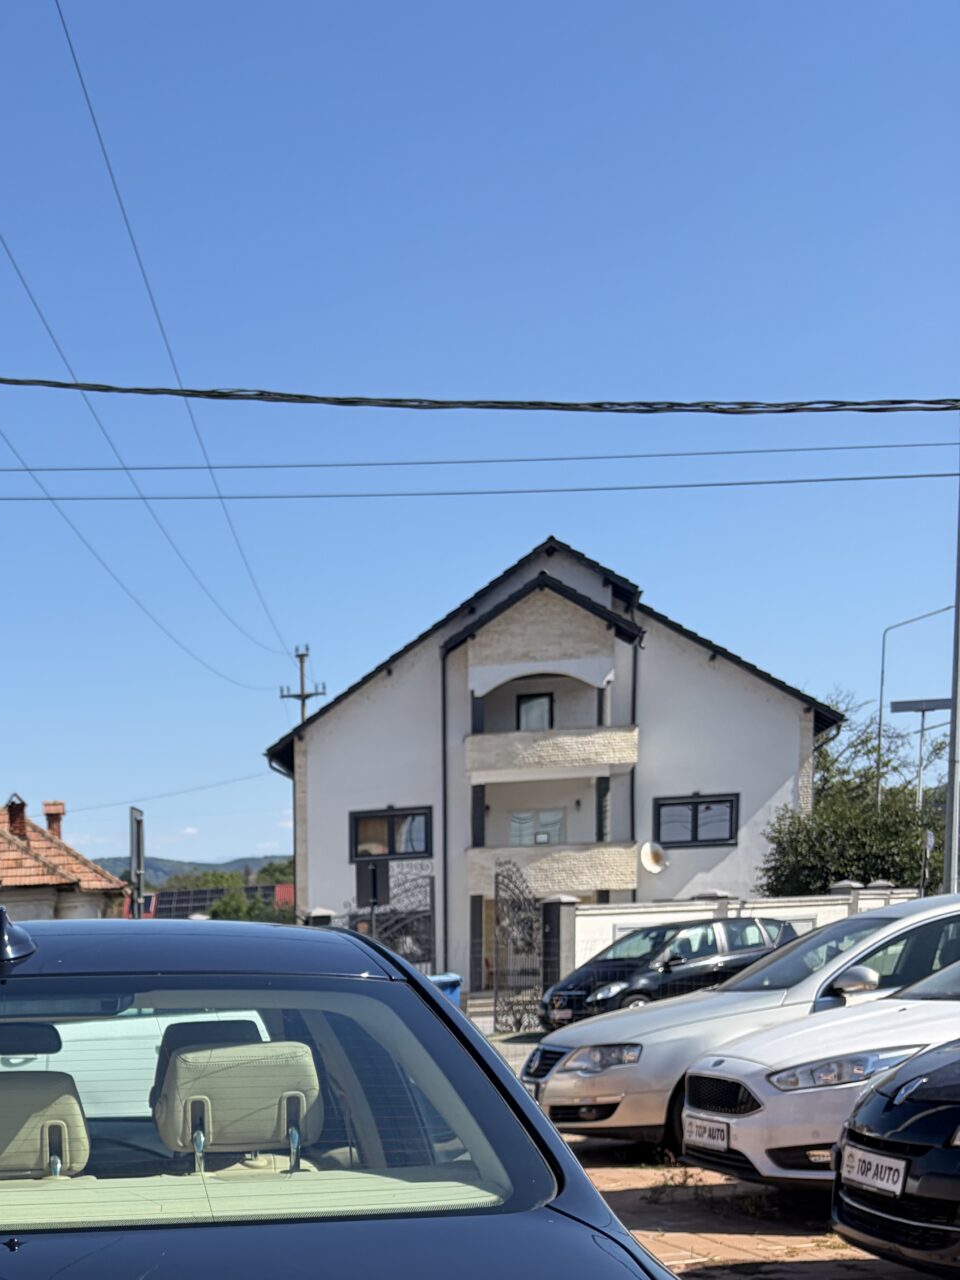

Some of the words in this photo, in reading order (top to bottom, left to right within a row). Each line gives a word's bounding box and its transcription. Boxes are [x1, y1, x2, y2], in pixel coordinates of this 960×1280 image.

[695, 1125, 707, 1138] TOP
[707, 1127, 725, 1142] AUTO
[857, 1158, 872, 1177] TOP
[872, 1163, 900, 1185] AUTO
